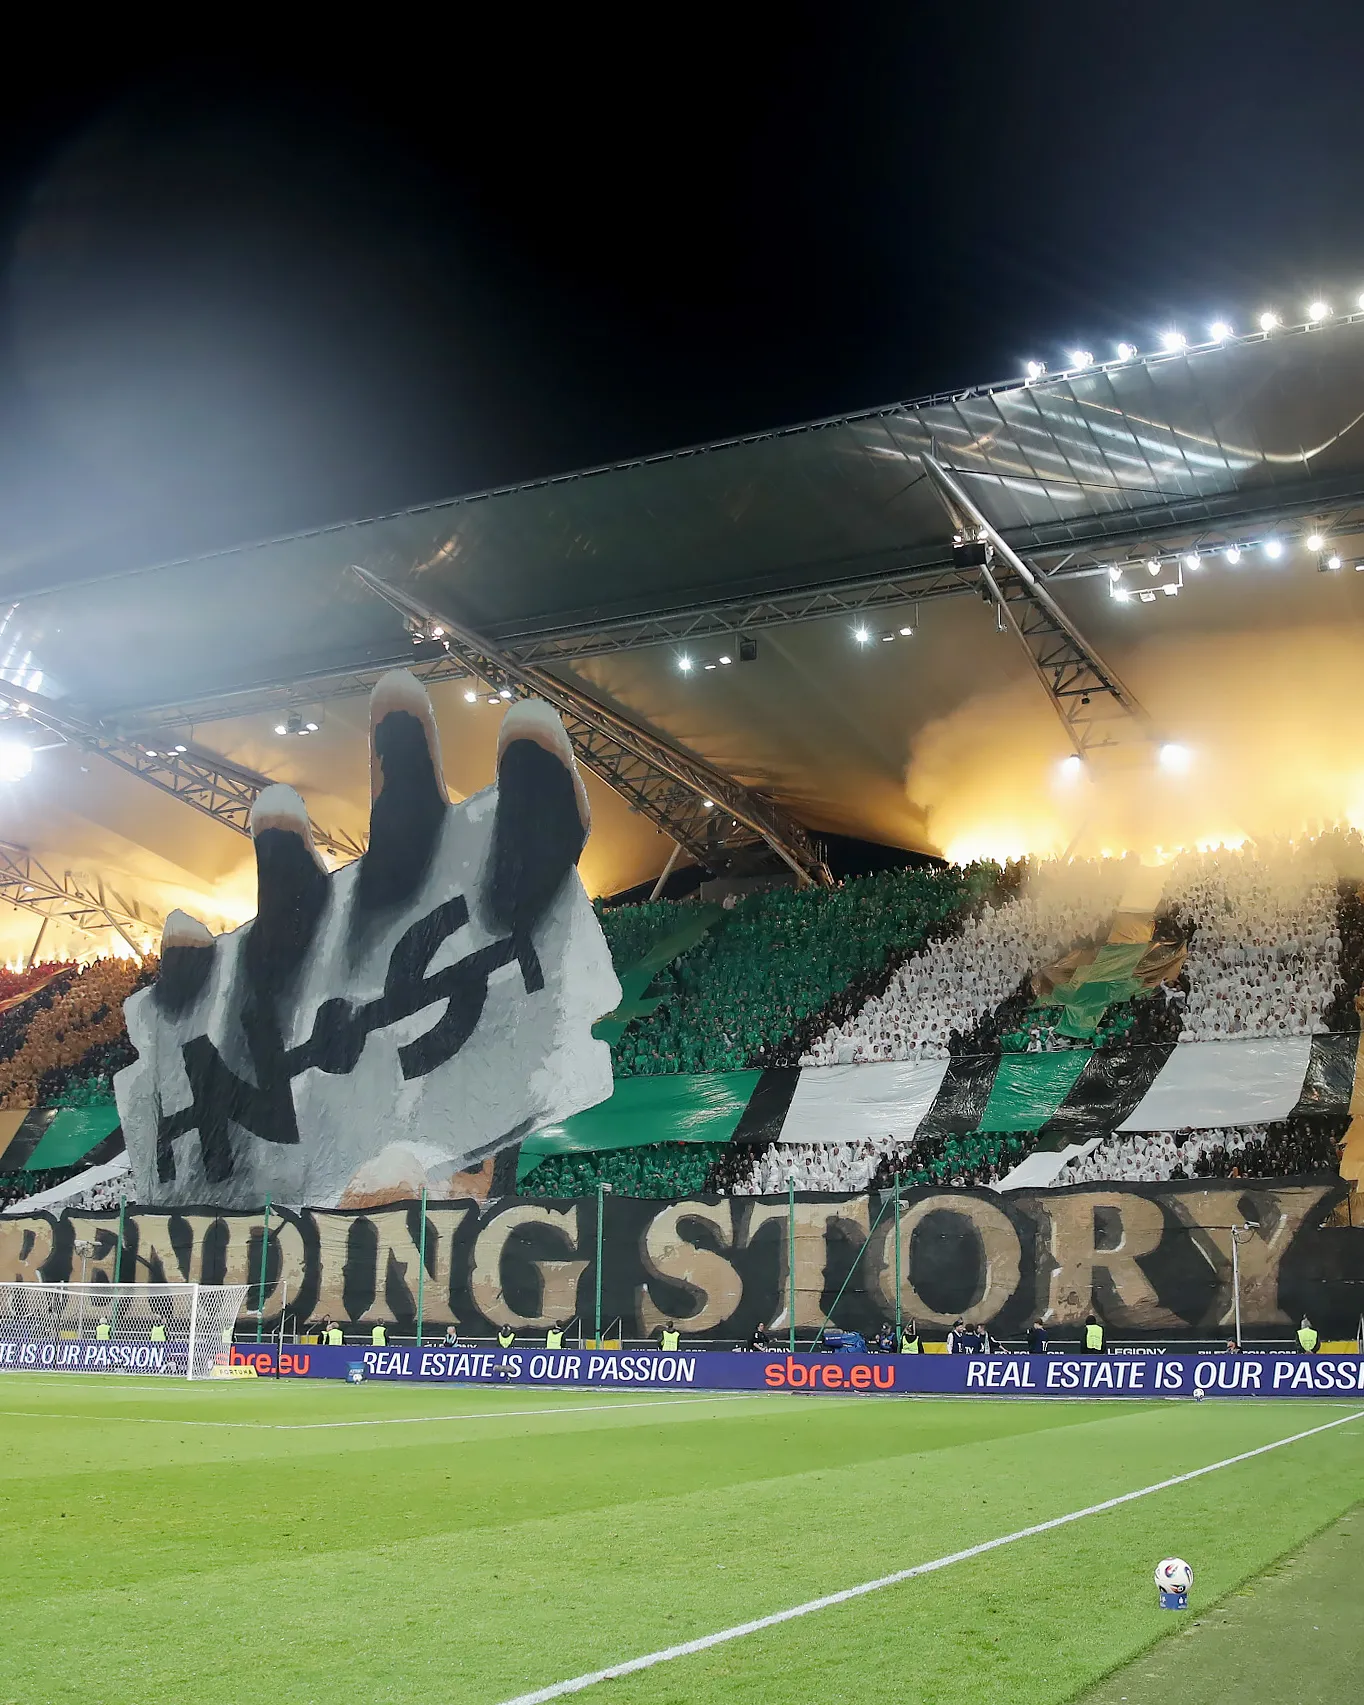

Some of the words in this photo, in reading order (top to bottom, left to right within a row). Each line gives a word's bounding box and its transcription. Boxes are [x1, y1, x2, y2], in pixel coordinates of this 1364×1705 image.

[637, 1186, 1333, 1332] STORY
[20, 1343, 37, 1364] IS
[42, 1344, 80, 1365] OUR
[84, 1345, 165, 1367] PASSION
[363, 1351, 413, 1375] REAL
[420, 1353, 495, 1378] ESTATE
[500, 1354, 523, 1378] IS
[529, 1355, 581, 1379] OUR
[587, 1356, 696, 1382] PASSION
[764, 1356, 895, 1389] sbre.eu
[966, 1361, 1036, 1387] REAL
[1046, 1361, 1146, 1388] ESTATE
[1154, 1361, 1183, 1388] IS
[1193, 1361, 1263, 1389] OUR
